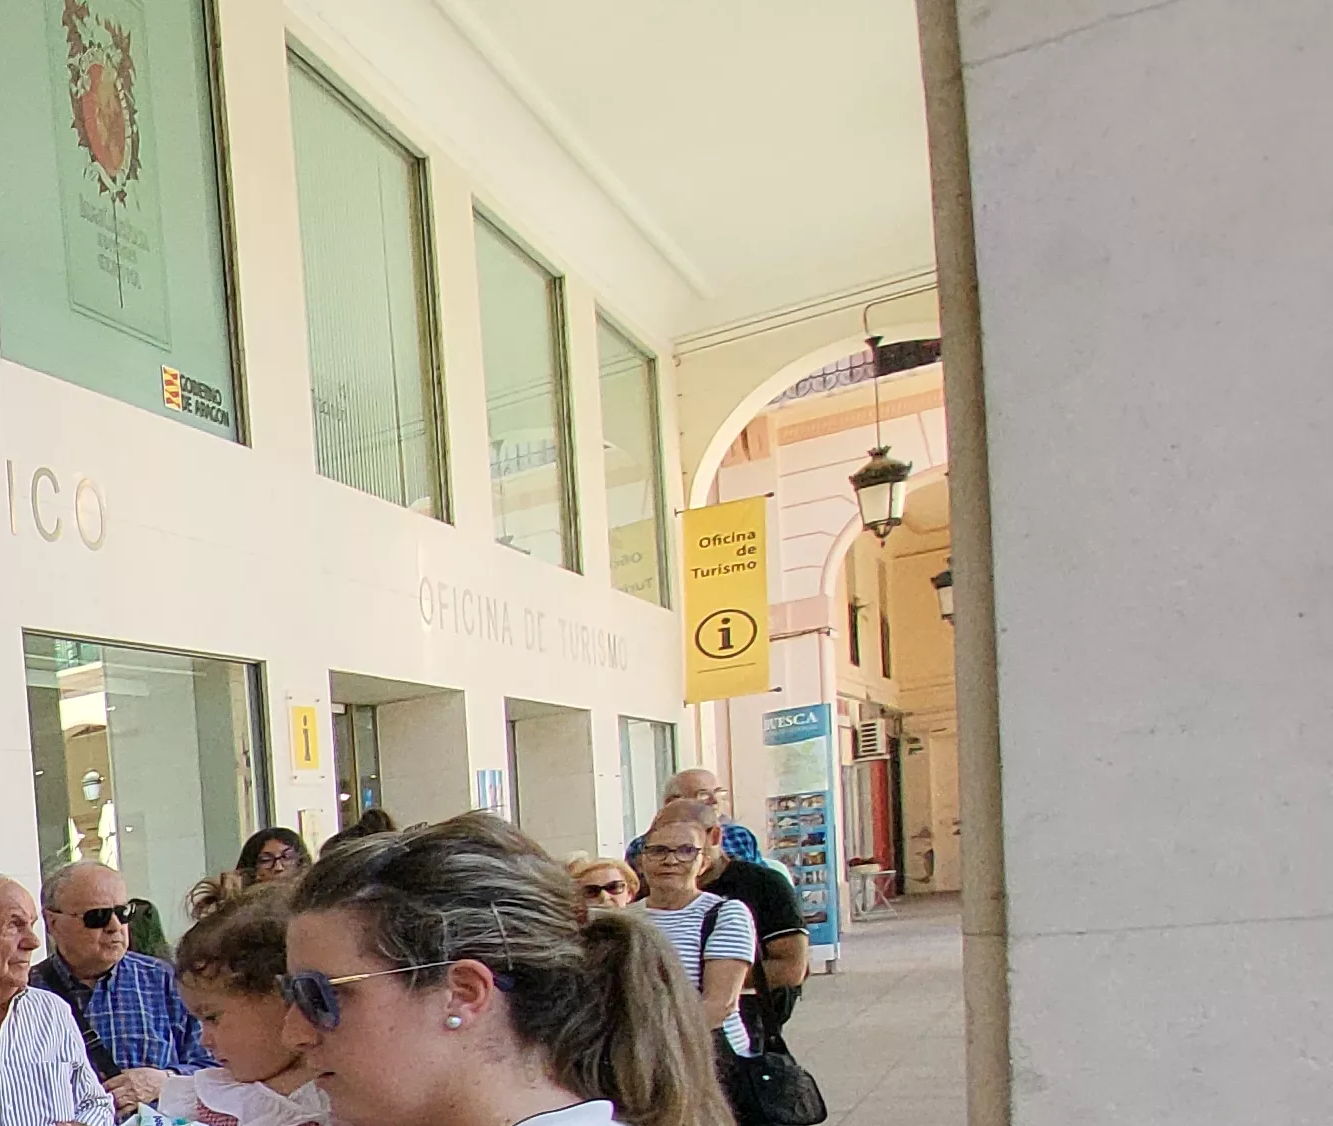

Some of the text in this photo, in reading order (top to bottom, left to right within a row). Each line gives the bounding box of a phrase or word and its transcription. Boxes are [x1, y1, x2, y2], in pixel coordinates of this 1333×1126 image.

[699, 530, 757, 549] Oficina
[736, 544, 758, 557] de
[691, 560, 757, 580] Turismo
[419, 575, 628, 672] OFICINA DE TURISMO
